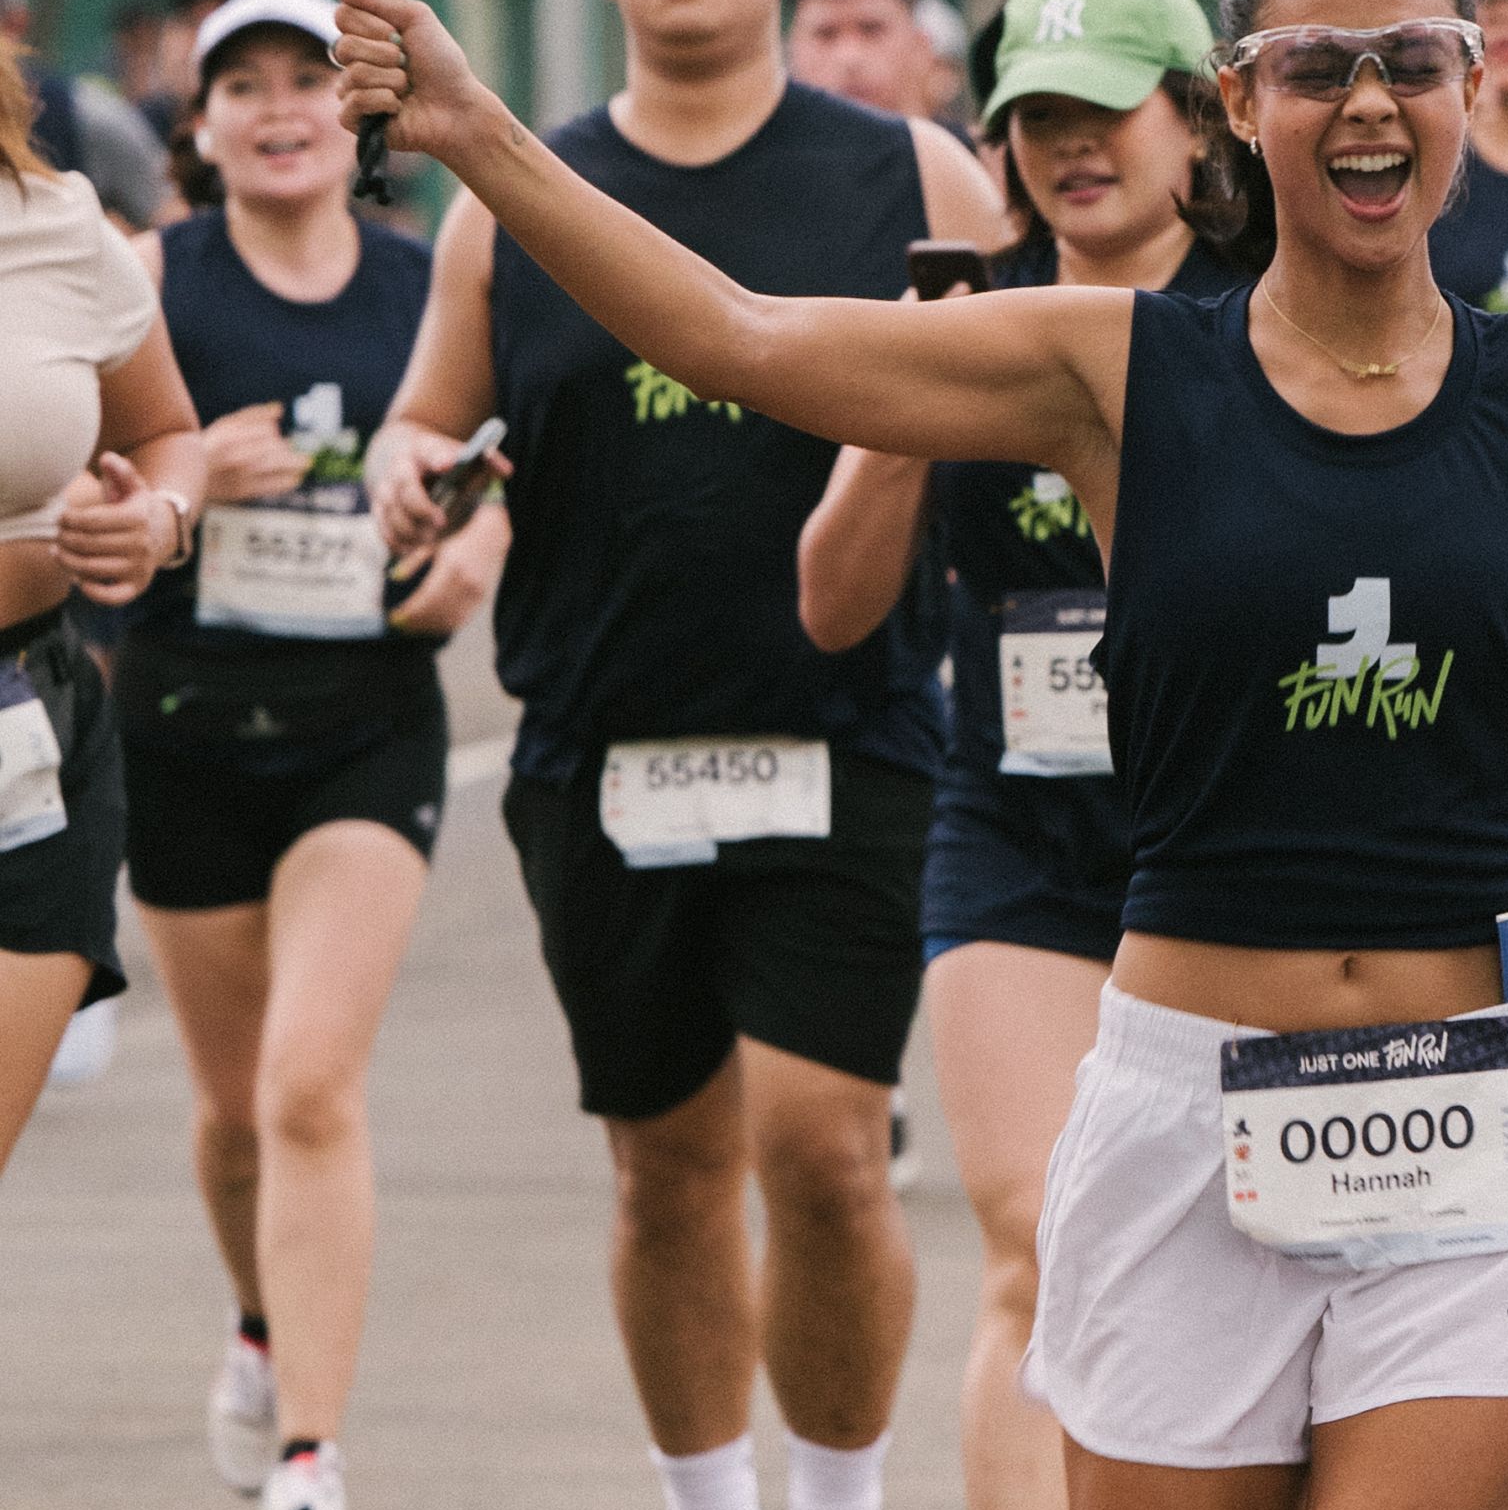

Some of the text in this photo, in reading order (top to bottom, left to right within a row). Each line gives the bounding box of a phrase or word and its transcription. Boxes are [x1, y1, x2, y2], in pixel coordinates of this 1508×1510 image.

[647, 748, 778, 789] 55450
[1299, 1053, 1339, 1075] JUST
[1342, 1050, 1380, 1070] ONE
[1280, 1105, 1474, 1163] 00000
[1332, 1165, 1431, 1194] Hannah
